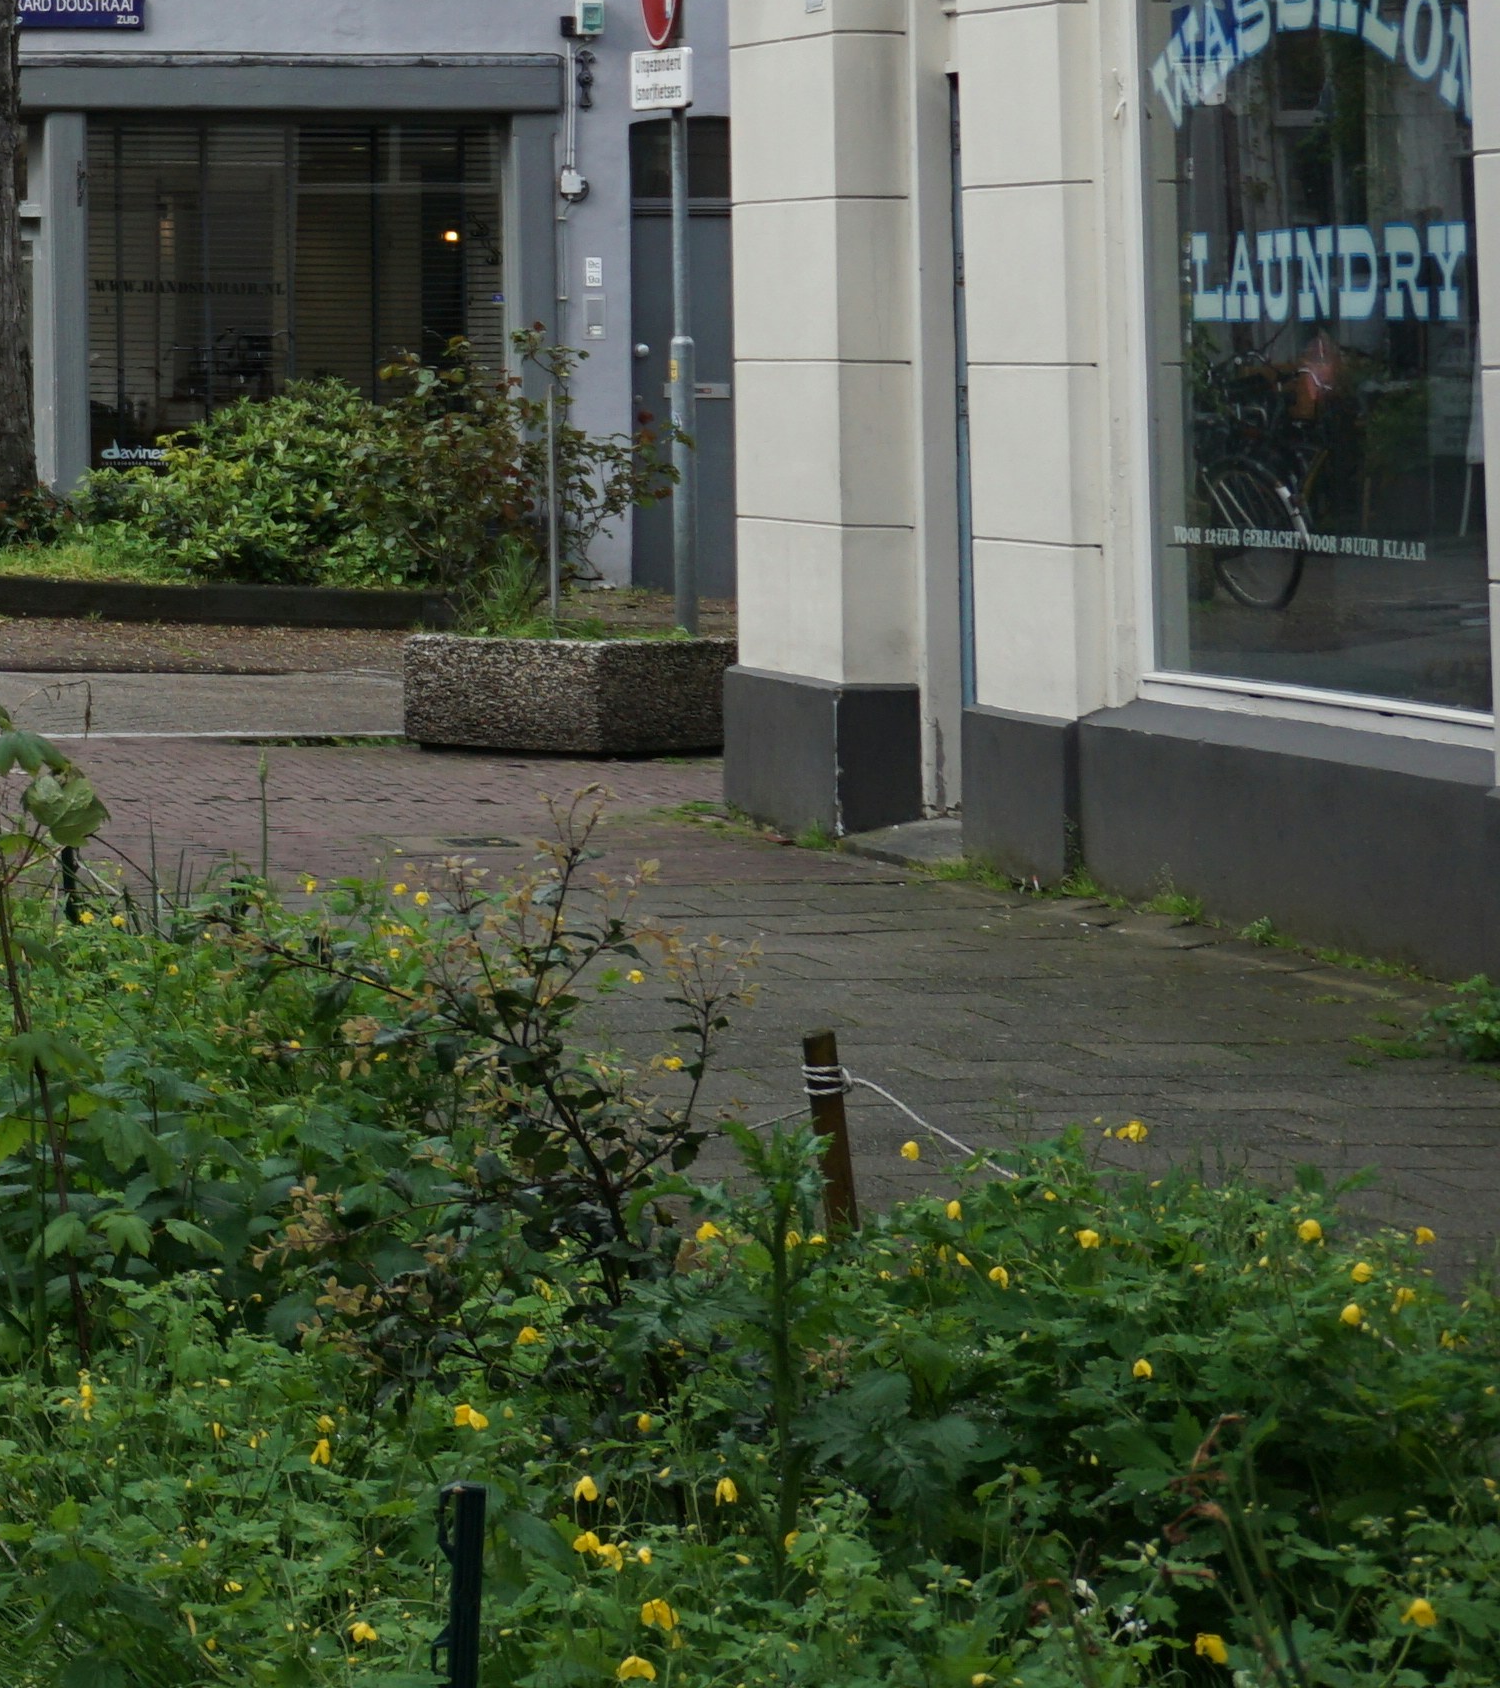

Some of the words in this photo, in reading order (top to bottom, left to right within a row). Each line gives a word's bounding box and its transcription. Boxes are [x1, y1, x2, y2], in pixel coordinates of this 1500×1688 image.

[117, 15, 139, 24] ZUID
[1191, 221, 1467, 324] LAUNDRY
[1174, 526, 1201, 544] VOOR
[1353, 538, 1378, 557] UUR
[1383, 540, 1426, 561] KLAAR
